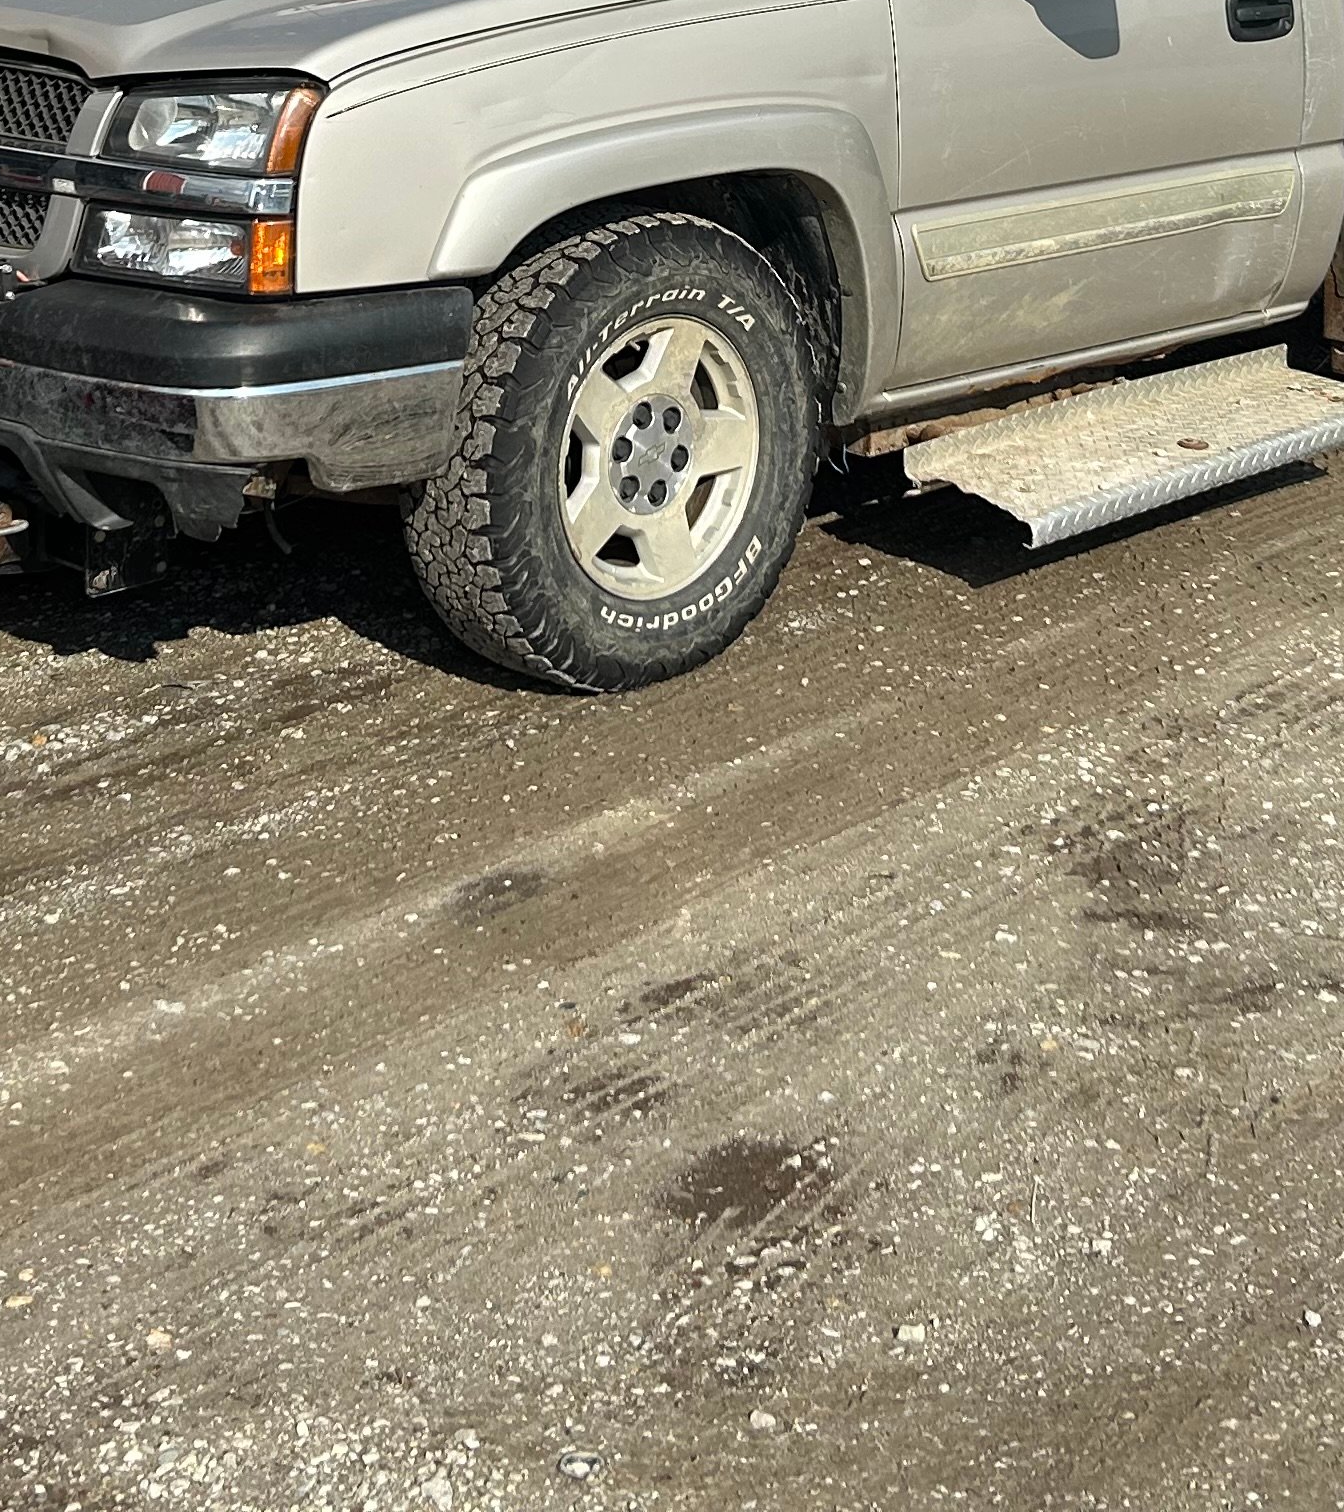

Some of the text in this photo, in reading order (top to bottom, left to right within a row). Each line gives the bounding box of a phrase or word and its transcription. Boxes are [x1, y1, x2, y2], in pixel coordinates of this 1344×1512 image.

[567, 285, 757, 402] All-Terrain T/A
[600, 535, 762, 633] BFGoodrich
